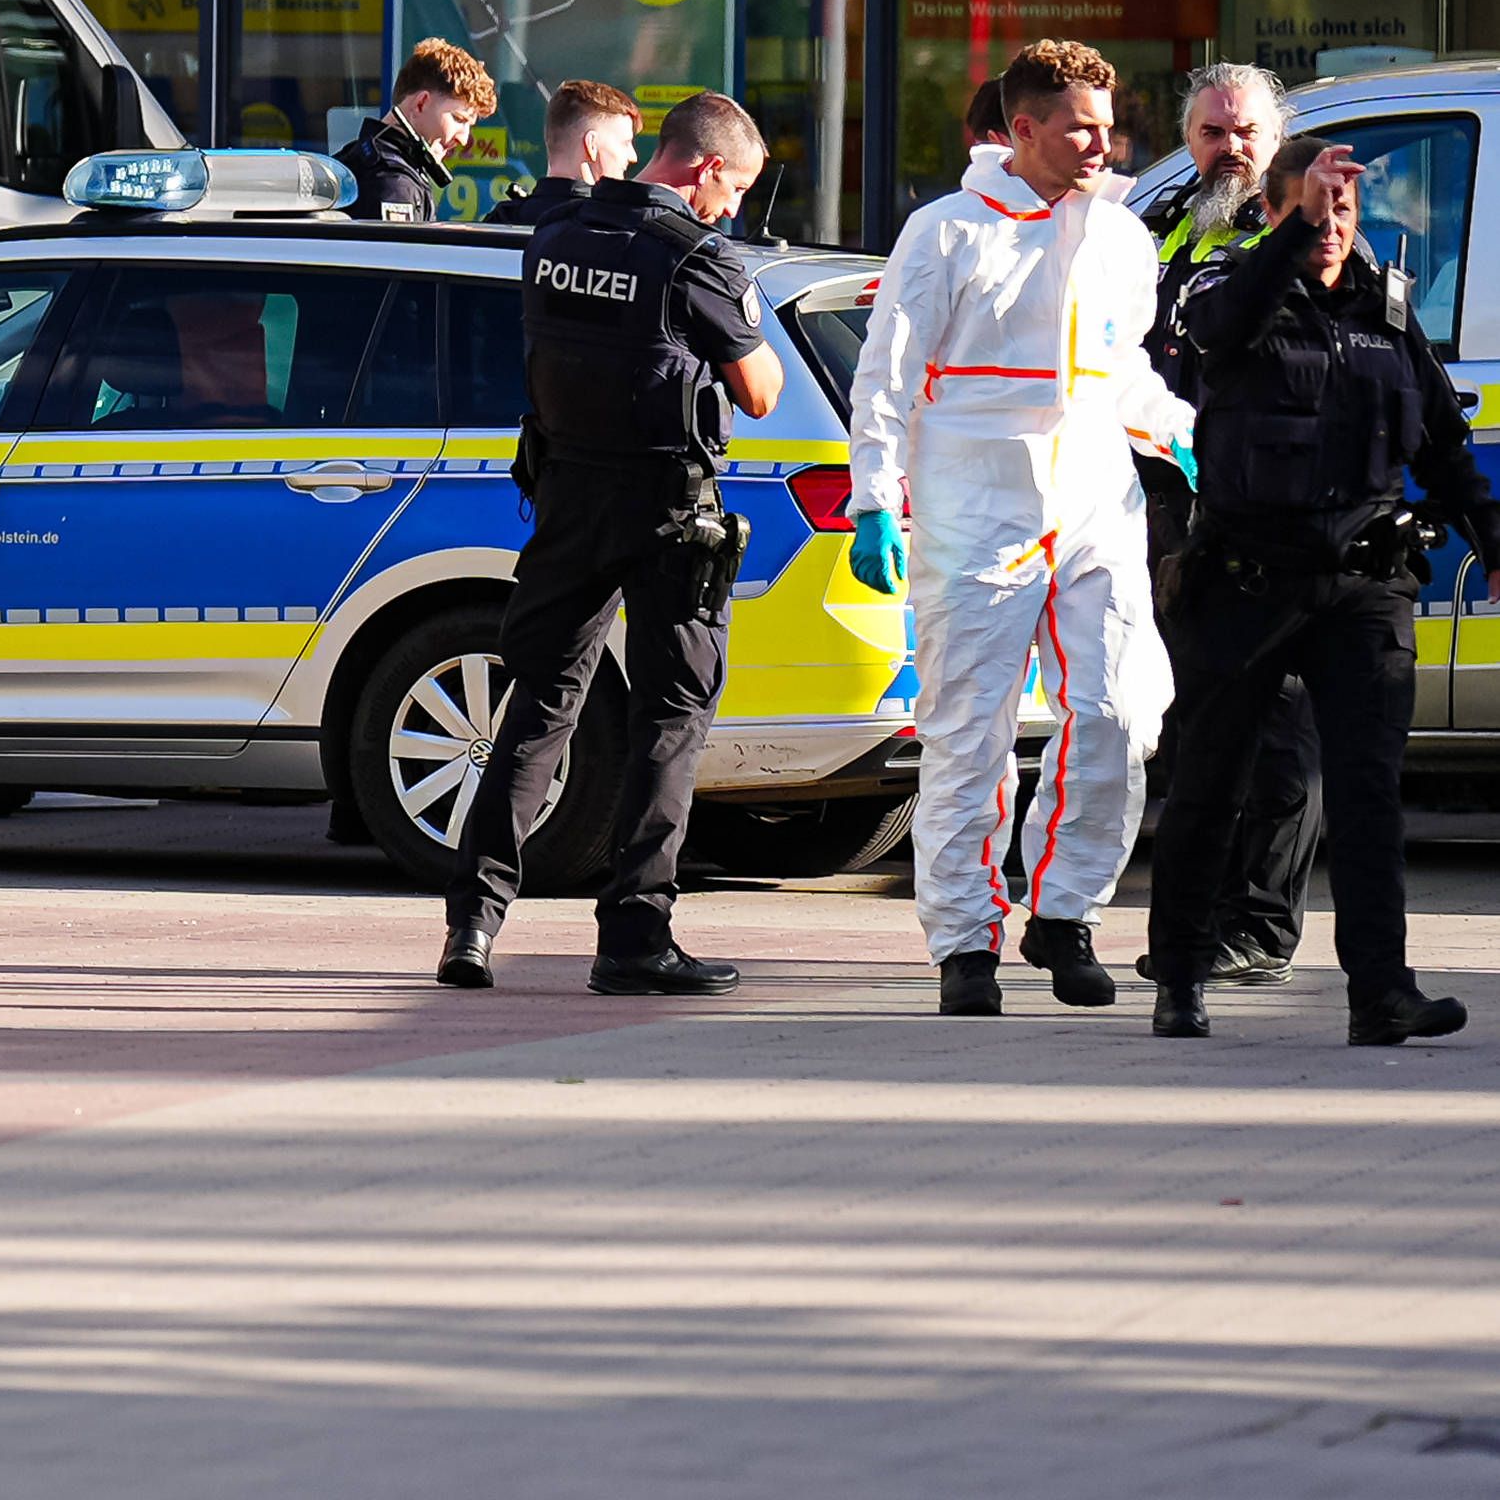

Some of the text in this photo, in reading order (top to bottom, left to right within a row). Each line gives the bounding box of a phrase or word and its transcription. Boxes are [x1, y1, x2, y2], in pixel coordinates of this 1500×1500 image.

[912, 0, 1124, 20] Deine Wochenangebote
[1255, 17, 1295, 36] Lidl
[1364, 16, 1406, 36] sich
[534, 258, 638, 302] POLIZEI
